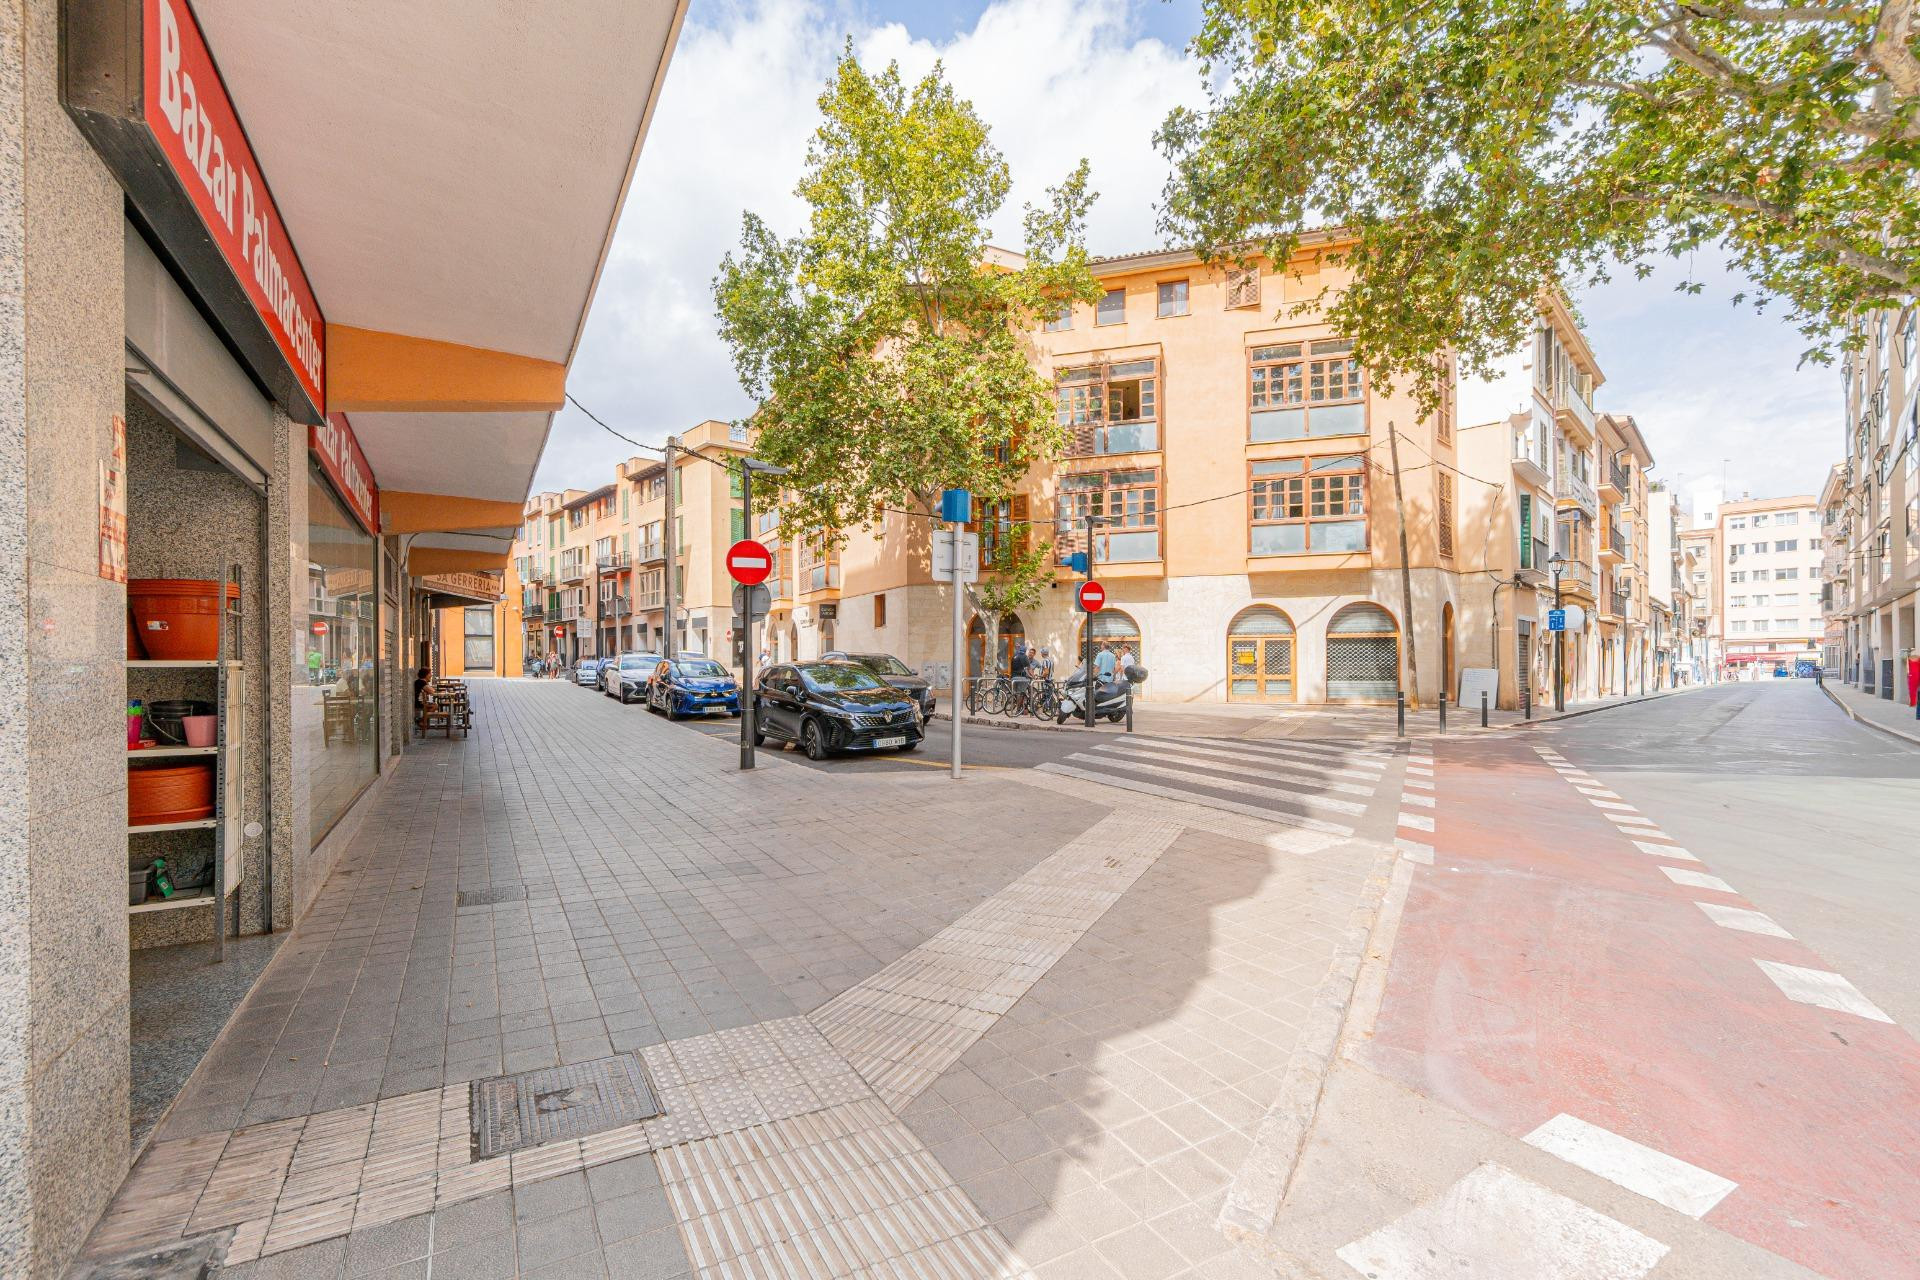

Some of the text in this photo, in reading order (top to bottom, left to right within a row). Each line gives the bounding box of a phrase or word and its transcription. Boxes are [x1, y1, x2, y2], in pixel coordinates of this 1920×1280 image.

[159, 0, 323, 394] Bazar Palmacenter
[450, 573, 491, 592] GERRERIA
